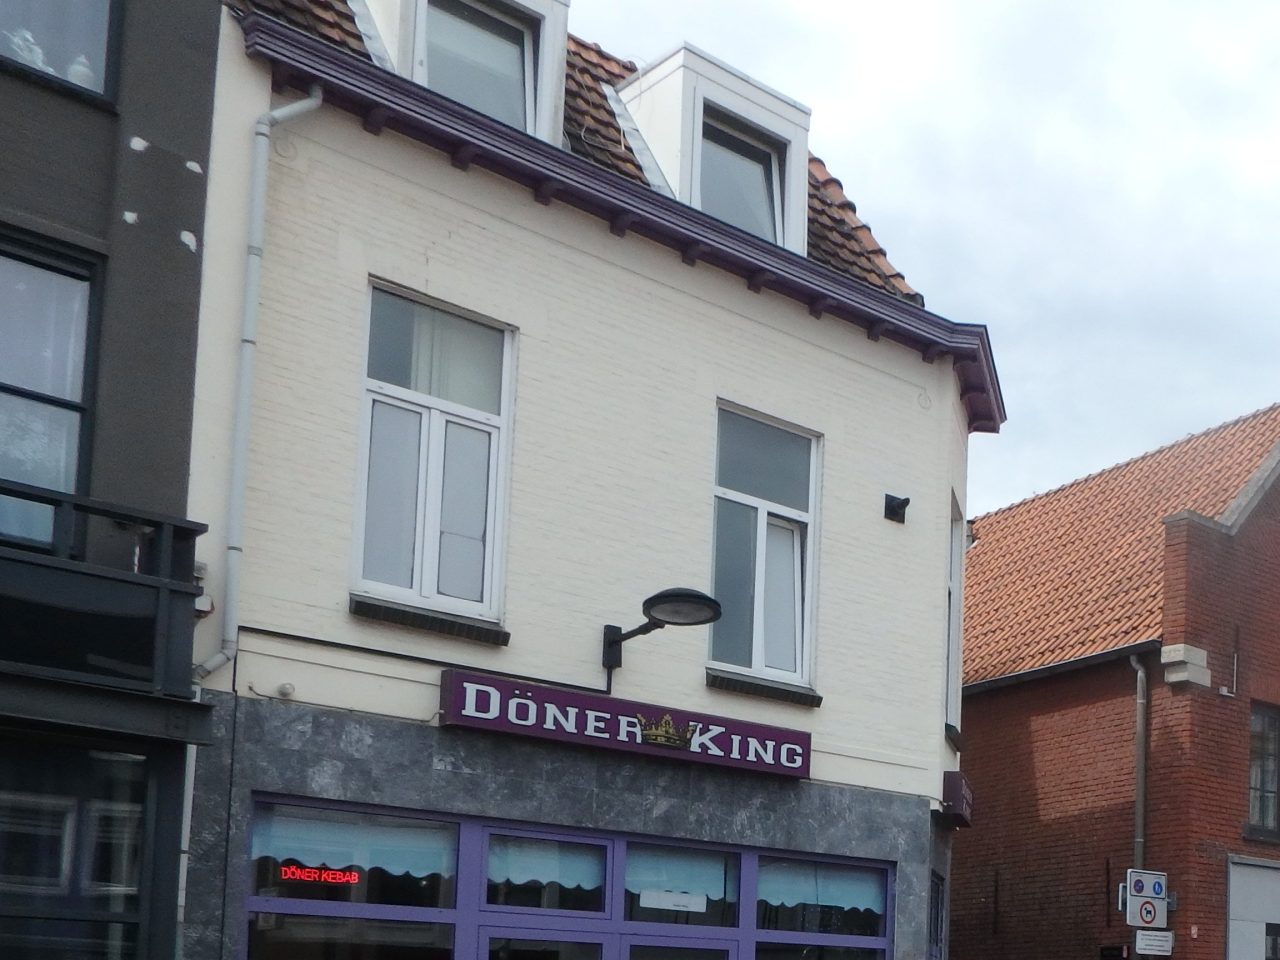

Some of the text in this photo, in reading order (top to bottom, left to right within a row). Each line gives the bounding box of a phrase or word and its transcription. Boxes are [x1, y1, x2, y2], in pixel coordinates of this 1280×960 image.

[461, 681, 803, 769] DÖNER KING
[281, 866, 359, 883] DÖNER KEBAB
